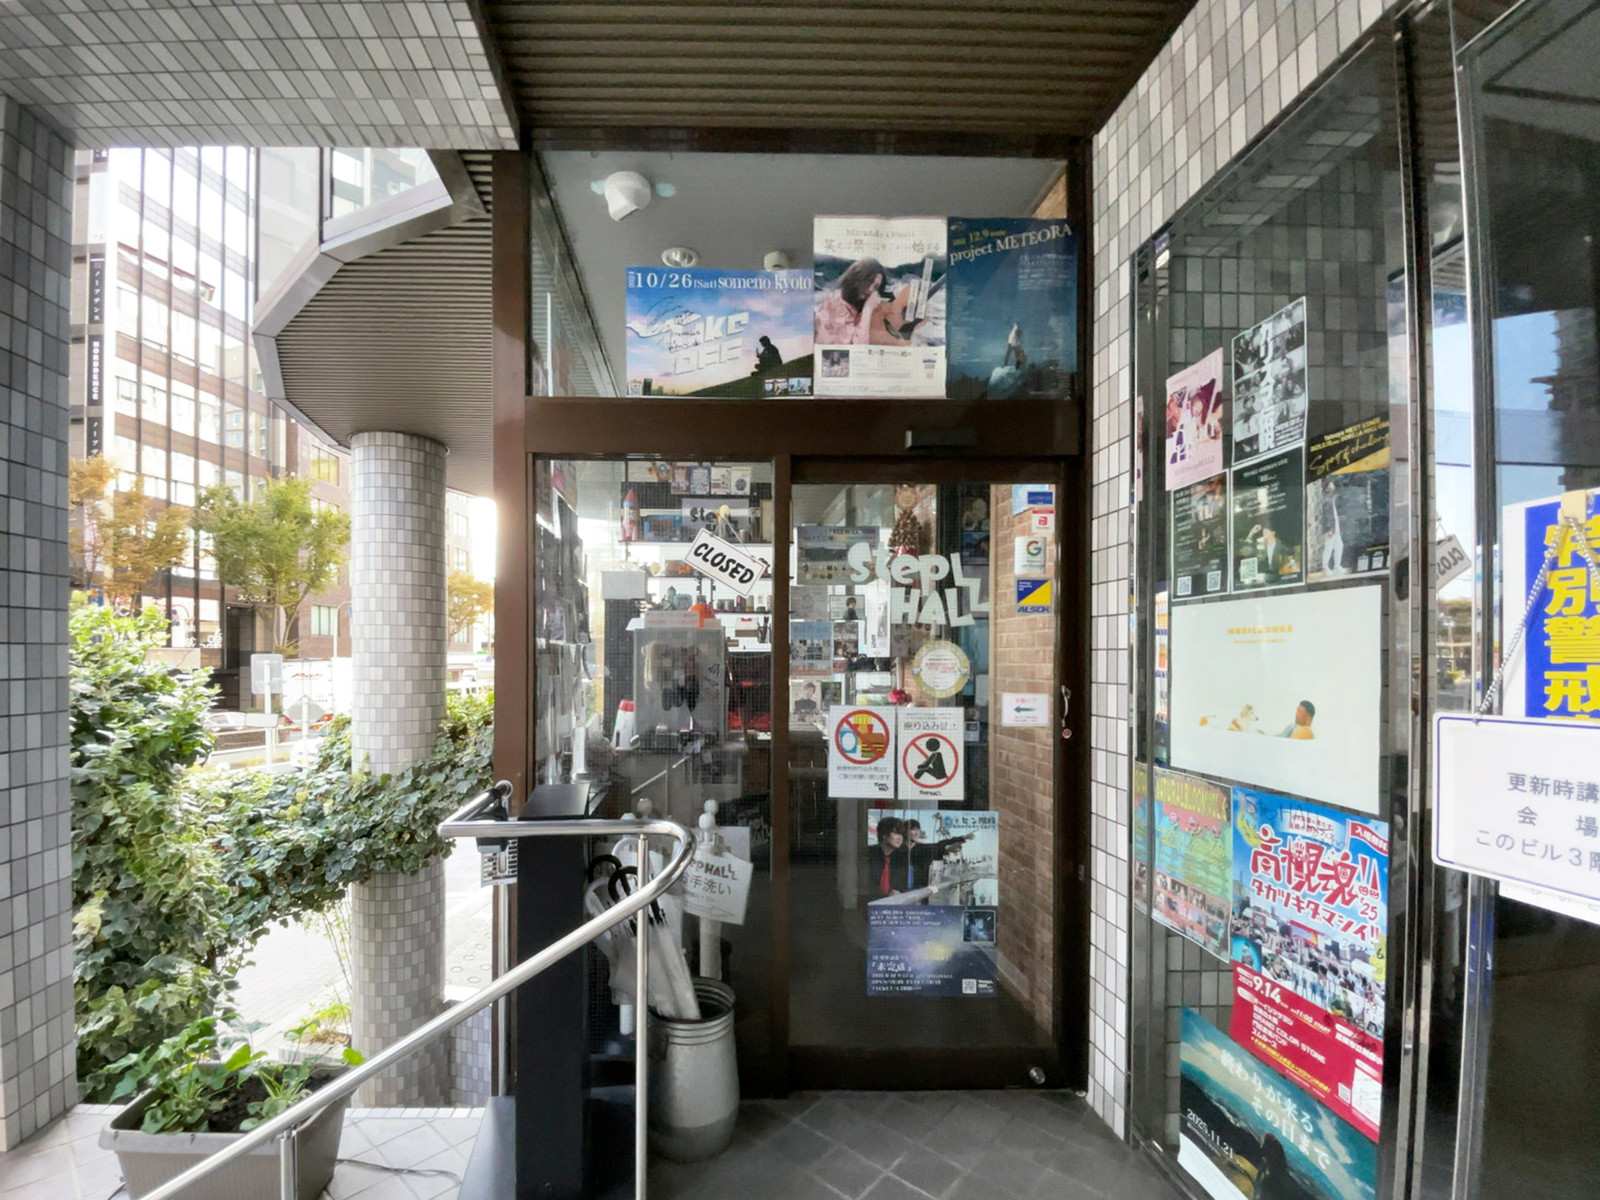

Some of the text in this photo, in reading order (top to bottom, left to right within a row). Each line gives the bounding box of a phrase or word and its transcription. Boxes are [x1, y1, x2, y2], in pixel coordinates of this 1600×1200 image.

[949, 243, 993, 266] project
[996, 223, 1073, 252] METEORA
[636, 272, 692, 289] 10/26
[718, 276, 772, 290] someno
[774, 273, 812, 293] kyoto
[693, 542, 755, 585] CLOSED
[847, 542, 951, 597] Step
[1017, 605, 1051, 614] ALSOK
[1507, 772, 1600, 804] 更新時講
[679, 873, 732, 895] お手洗い
[690, 859, 738, 881] epHALL
[1252, 976, 1281, 1004] 9.14
[1186, 1108, 1234, 1160] 2025.11.21
[1250, 1096, 1331, 1170] その日まで
